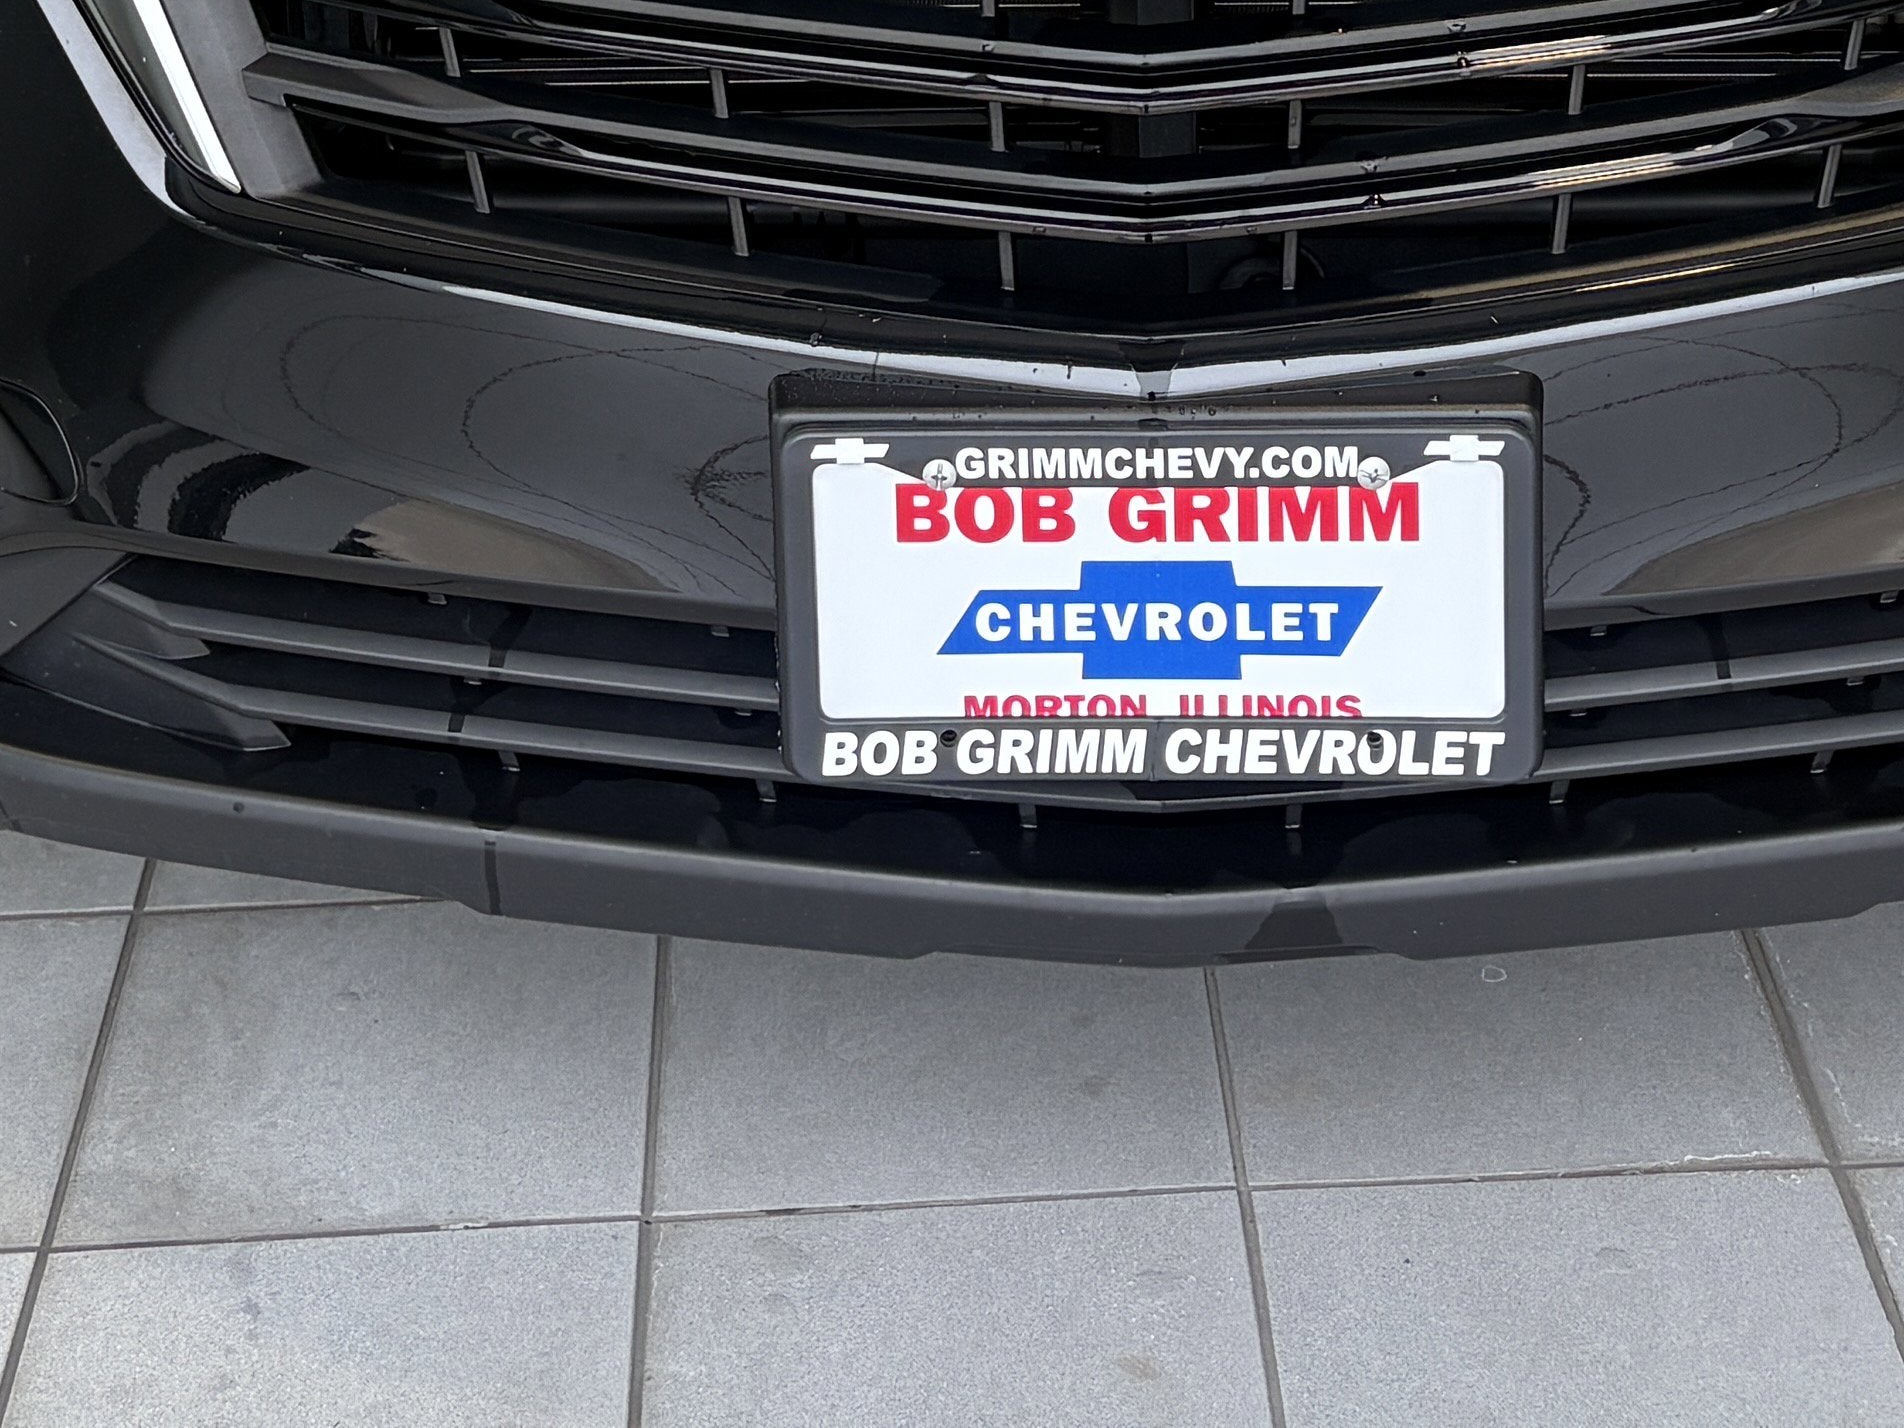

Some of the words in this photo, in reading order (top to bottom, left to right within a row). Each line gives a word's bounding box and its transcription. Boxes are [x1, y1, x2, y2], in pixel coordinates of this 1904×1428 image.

[955, 446, 1358, 481] GRIMMCHEVY.COM
[895, 482, 1075, 542] BOB
[1109, 482, 1420, 542] GRIMM
[975, 602, 1340, 642] CHEVROLET
[822, 729, 938, 776] BOB
[956, 728, 1147, 775] GRIMM
[1165, 728, 1505, 775] CHEVROLET
